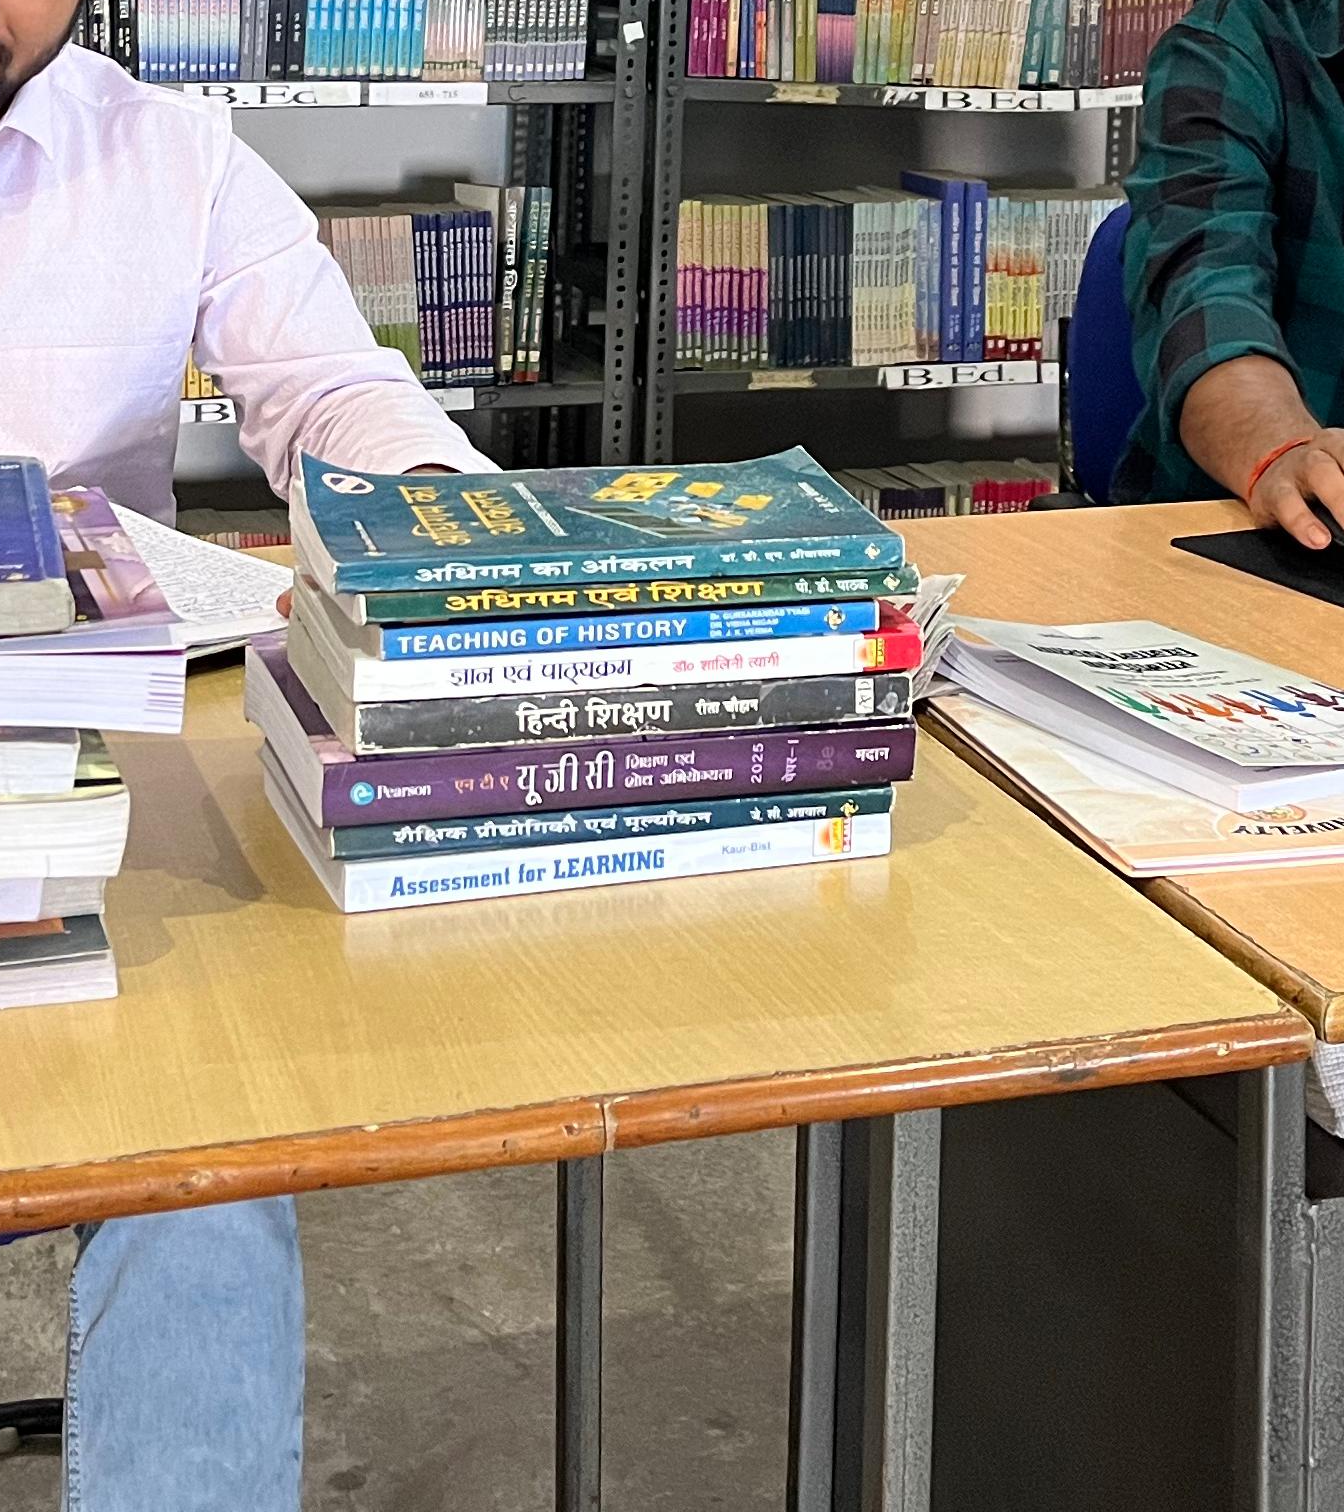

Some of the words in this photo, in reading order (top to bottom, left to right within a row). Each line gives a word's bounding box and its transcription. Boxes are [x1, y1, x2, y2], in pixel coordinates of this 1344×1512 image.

[939, 90, 1054, 112] B.Ed.
[900, 364, 1014, 386] B.Ed.
[415, 563, 523, 583] अधिगम
[529, 561, 574, 578] का
[580, 554, 696, 575] आंकलन
[445, 588, 578, 612] अधिगम
[584, 583, 640, 610] एवं
[646, 580, 765, 604] शिक्षण
[836, 577, 870, 593] पाठक
[397, 628, 527, 654] TEACHING
[536, 625, 569, 645] OF
[577, 618, 688, 642] HISTORY
[449, 667, 495, 687] ज्ञान
[502, 663, 532, 684] एवं
[541, 658, 633, 686] पाठ्यक्रम
[700, 651, 744, 671] शालिनी
[747, 650, 780, 668] त्यागी
[516, 698, 579, 735] हिन्दी
[585, 696, 673, 729] शिक्षण
[695, 699, 720, 716] रीता
[723, 696, 759, 720] चौहान
[751, 742, 764, 784] 2025
[855, 746, 891, 762] मदान
[454, 777, 474, 794] एन
[500, 775, 509, 791] ए
[516, 765, 543, 806] यू
[543, 753, 579, 793] जी
[584, 750, 615, 790] सी
[377, 783, 431, 800] Pearson
[584, 813, 618, 834] एवं
[390, 868, 511, 898] Assessment
[519, 863, 546, 884] for
[553, 848, 665, 879] LEARNING
